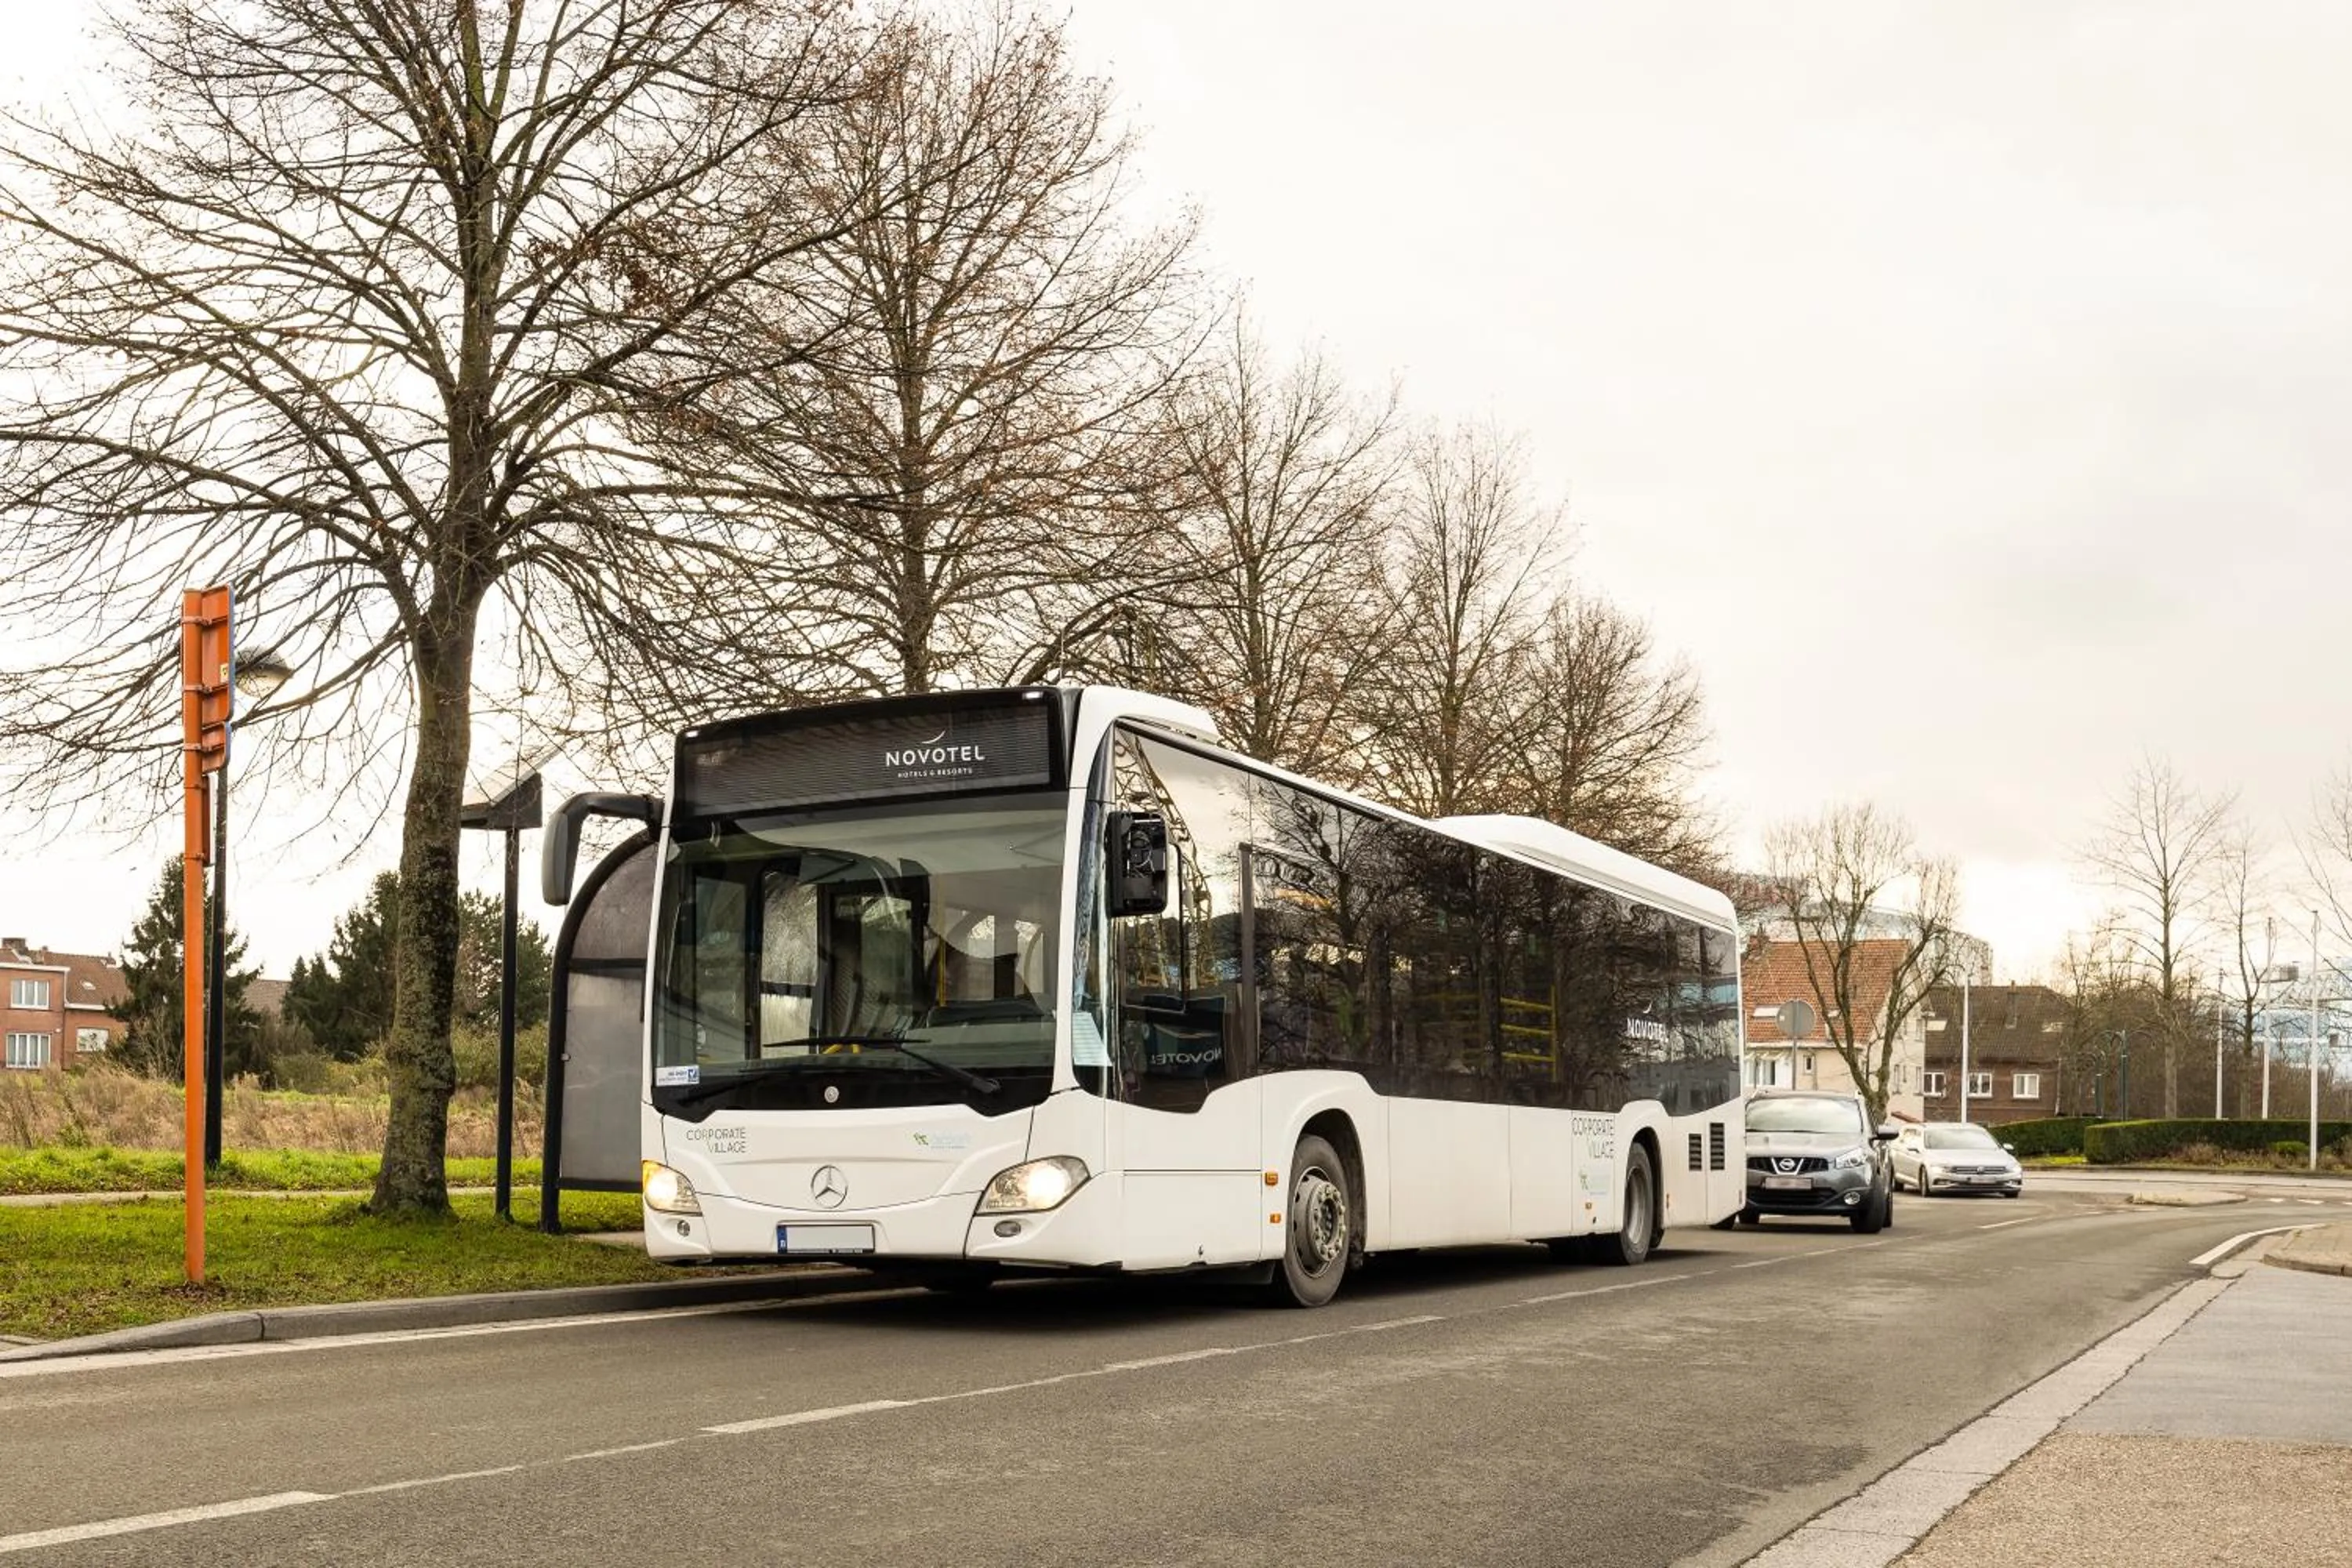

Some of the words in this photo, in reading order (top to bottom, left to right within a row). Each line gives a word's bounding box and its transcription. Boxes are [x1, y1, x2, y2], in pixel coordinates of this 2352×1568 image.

[885, 746, 985, 767] NOVOTEL
[937, 768, 973, 776] RESORTS
[1627, 1018, 1669, 1043] NOVOTEL
[686, 1127, 746, 1140] CORPORATE
[1571, 1117, 1614, 1136] CORPORATE
[707, 1141, 746, 1153] VILLAGE
[1586, 1138, 1614, 1160] VILLAGE
